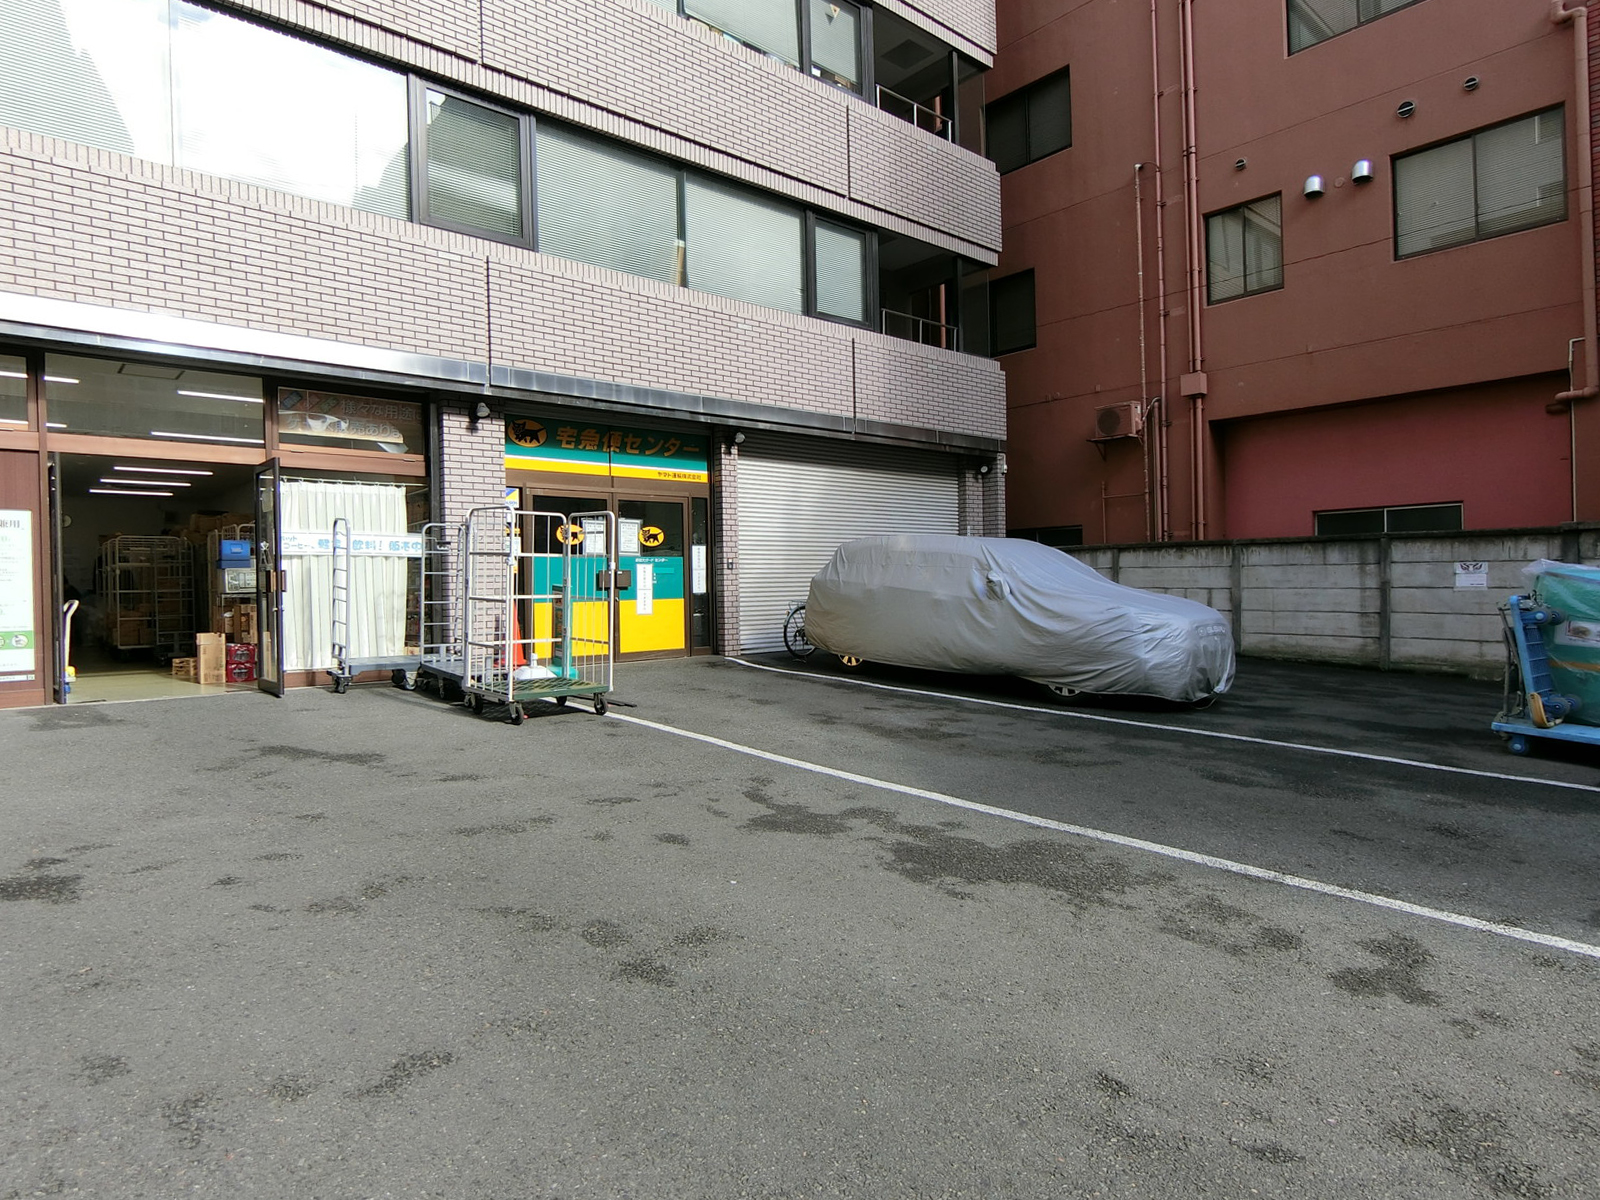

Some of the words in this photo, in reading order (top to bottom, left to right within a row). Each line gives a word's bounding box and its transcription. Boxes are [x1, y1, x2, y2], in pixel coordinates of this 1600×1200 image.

[556, 427, 700, 457] 宅急便センター
[657, 471, 702, 480] ヤマト運輸株式会社
